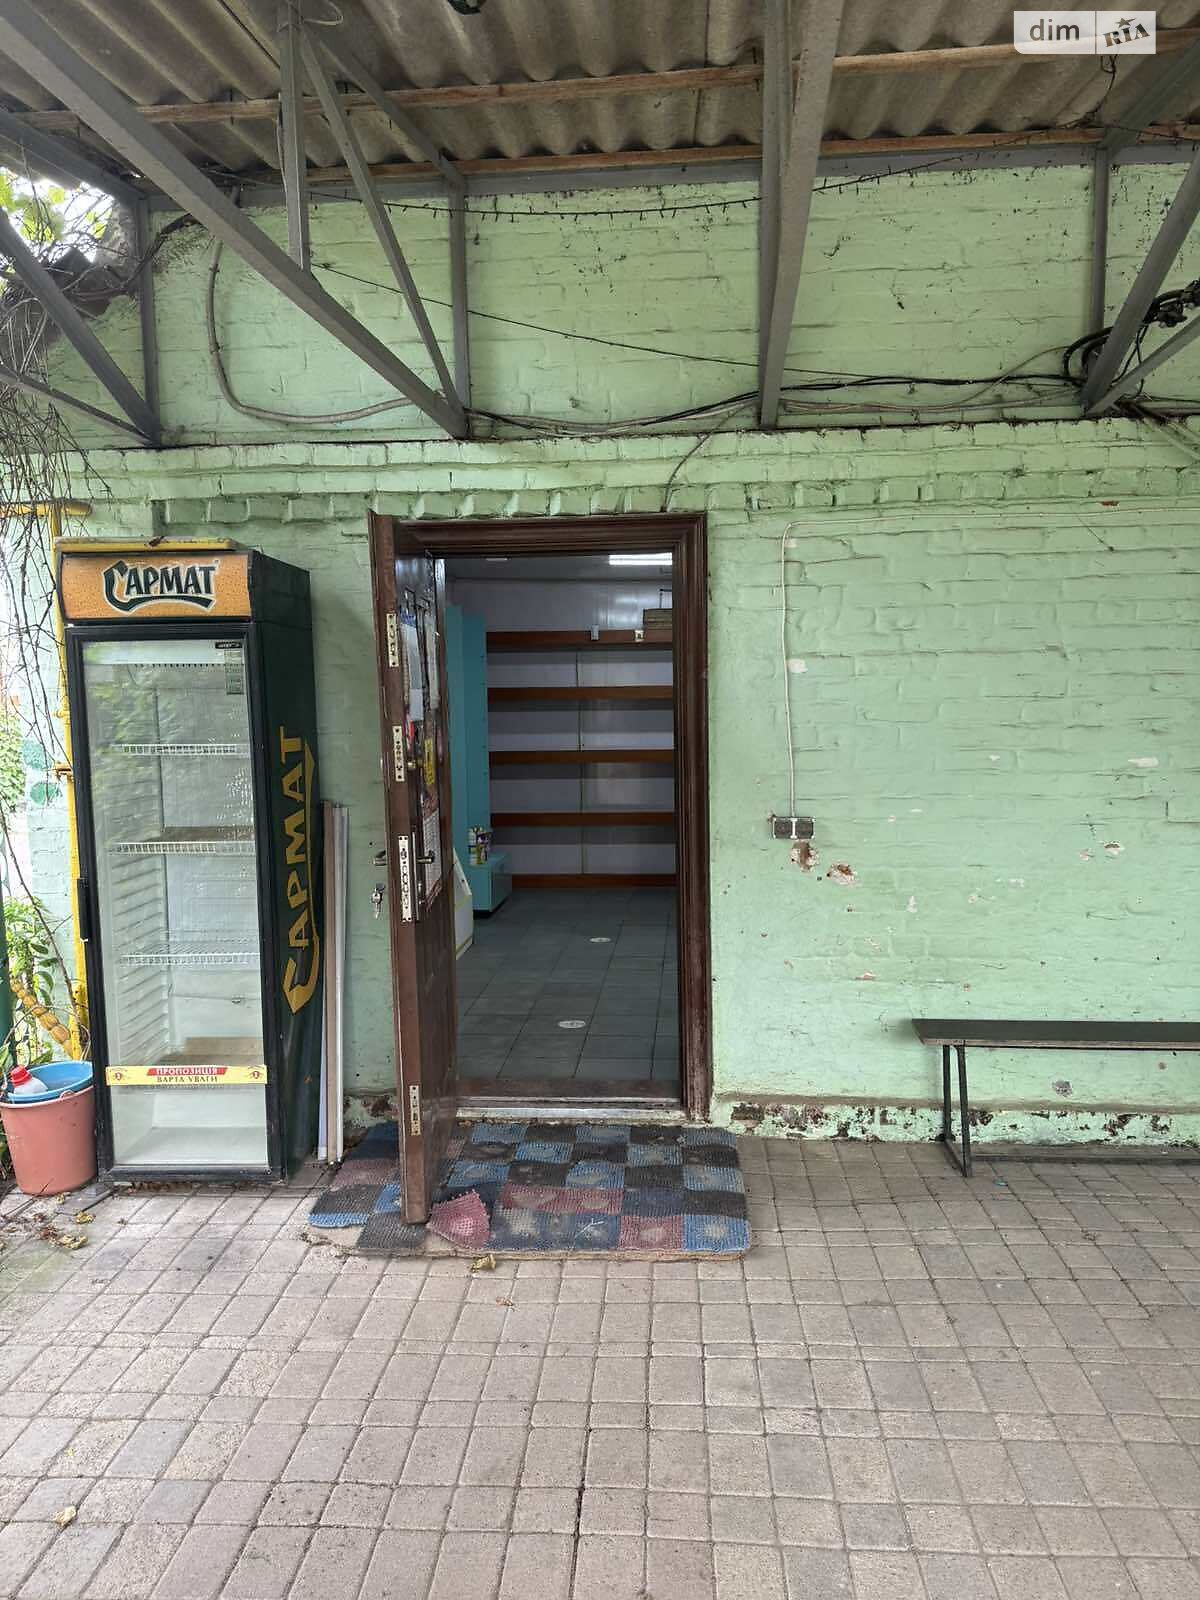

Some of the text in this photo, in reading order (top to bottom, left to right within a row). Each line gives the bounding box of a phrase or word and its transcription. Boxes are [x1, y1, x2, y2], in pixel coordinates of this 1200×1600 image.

[104, 559, 216, 613] САРМАТ
[280, 725, 320, 1014] САРМАТ
[157, 1067, 218, 1076] ПРОПОЗИЦІЯ
